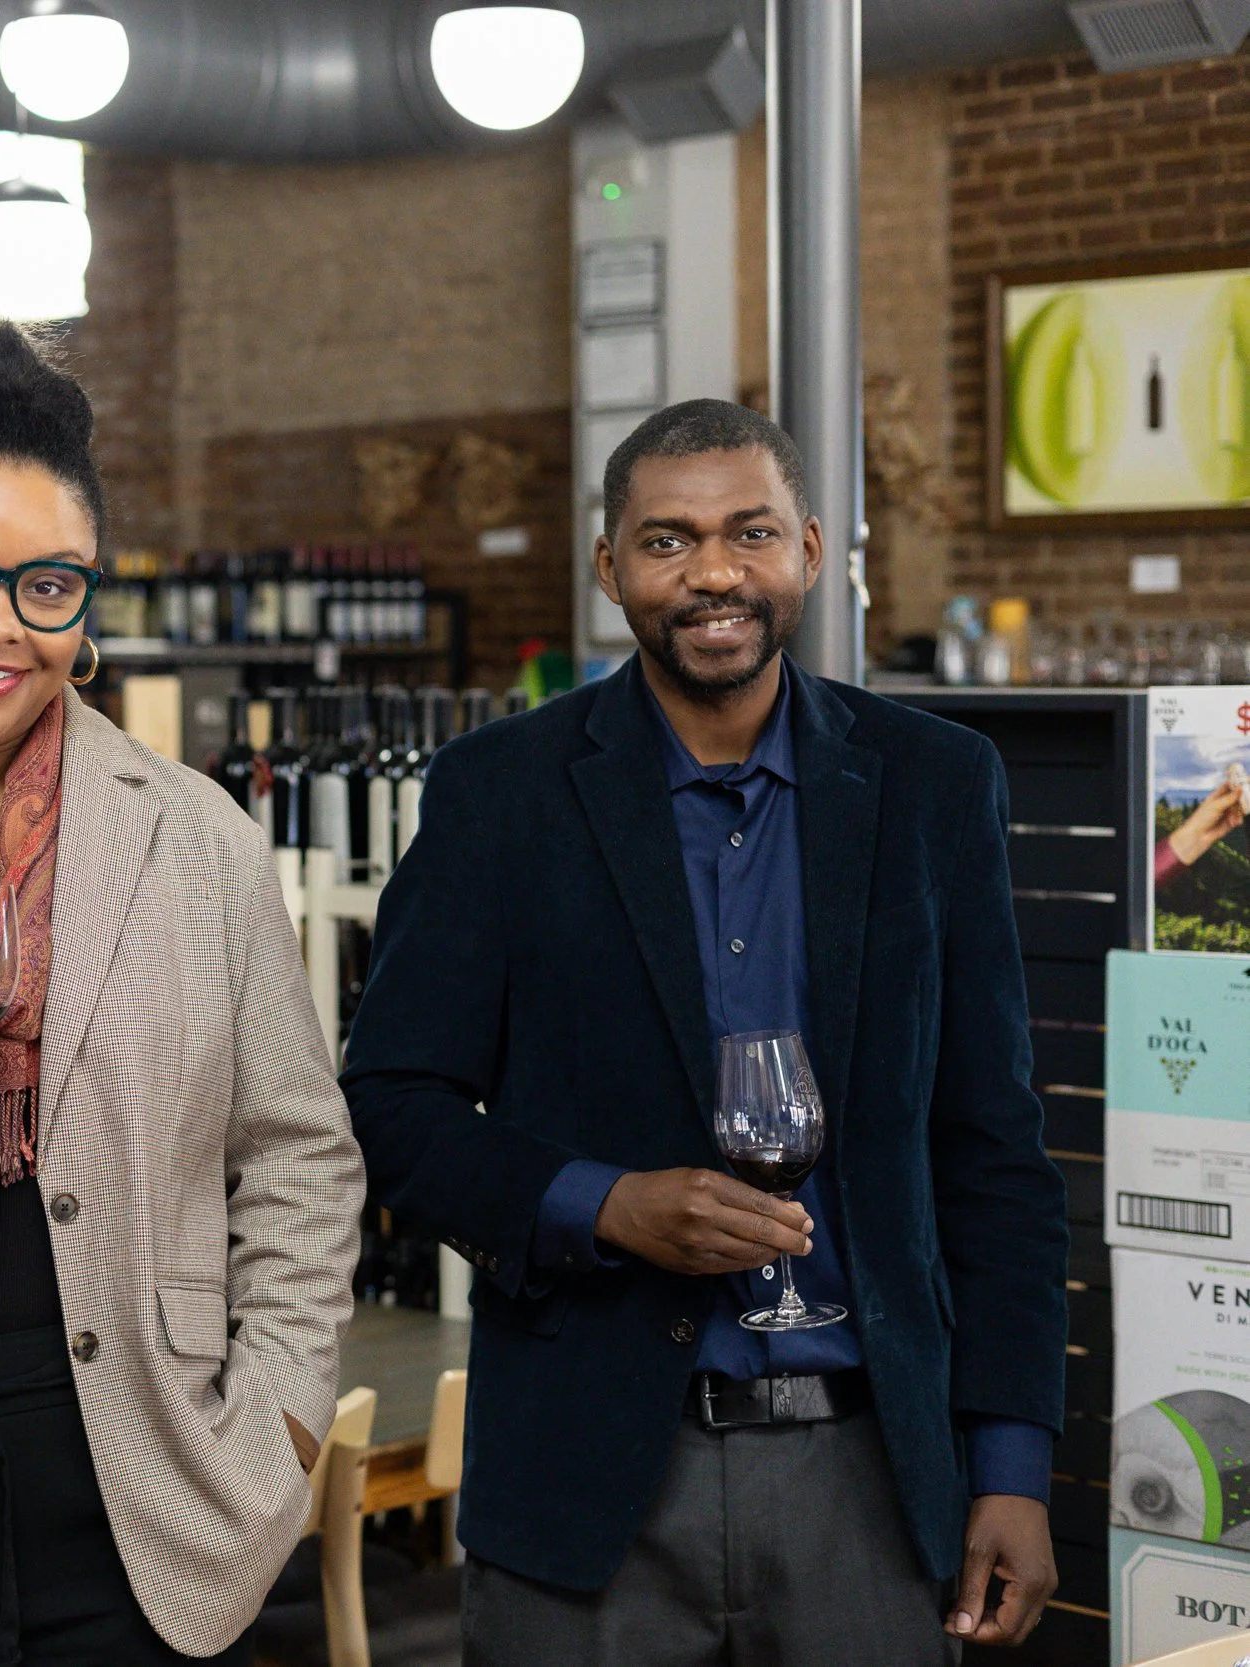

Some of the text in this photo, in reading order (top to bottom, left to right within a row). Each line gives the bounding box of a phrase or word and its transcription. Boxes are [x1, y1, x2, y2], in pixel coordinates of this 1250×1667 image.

[1160, 1016, 1196, 1033] VAL
[1148, 1034, 1207, 1053] D'OCA
[1188, 1281, 1250, 1308] VEN
[1216, 1312, 1231, 1324] DI
[1175, 1595, 1250, 1628] BOT
